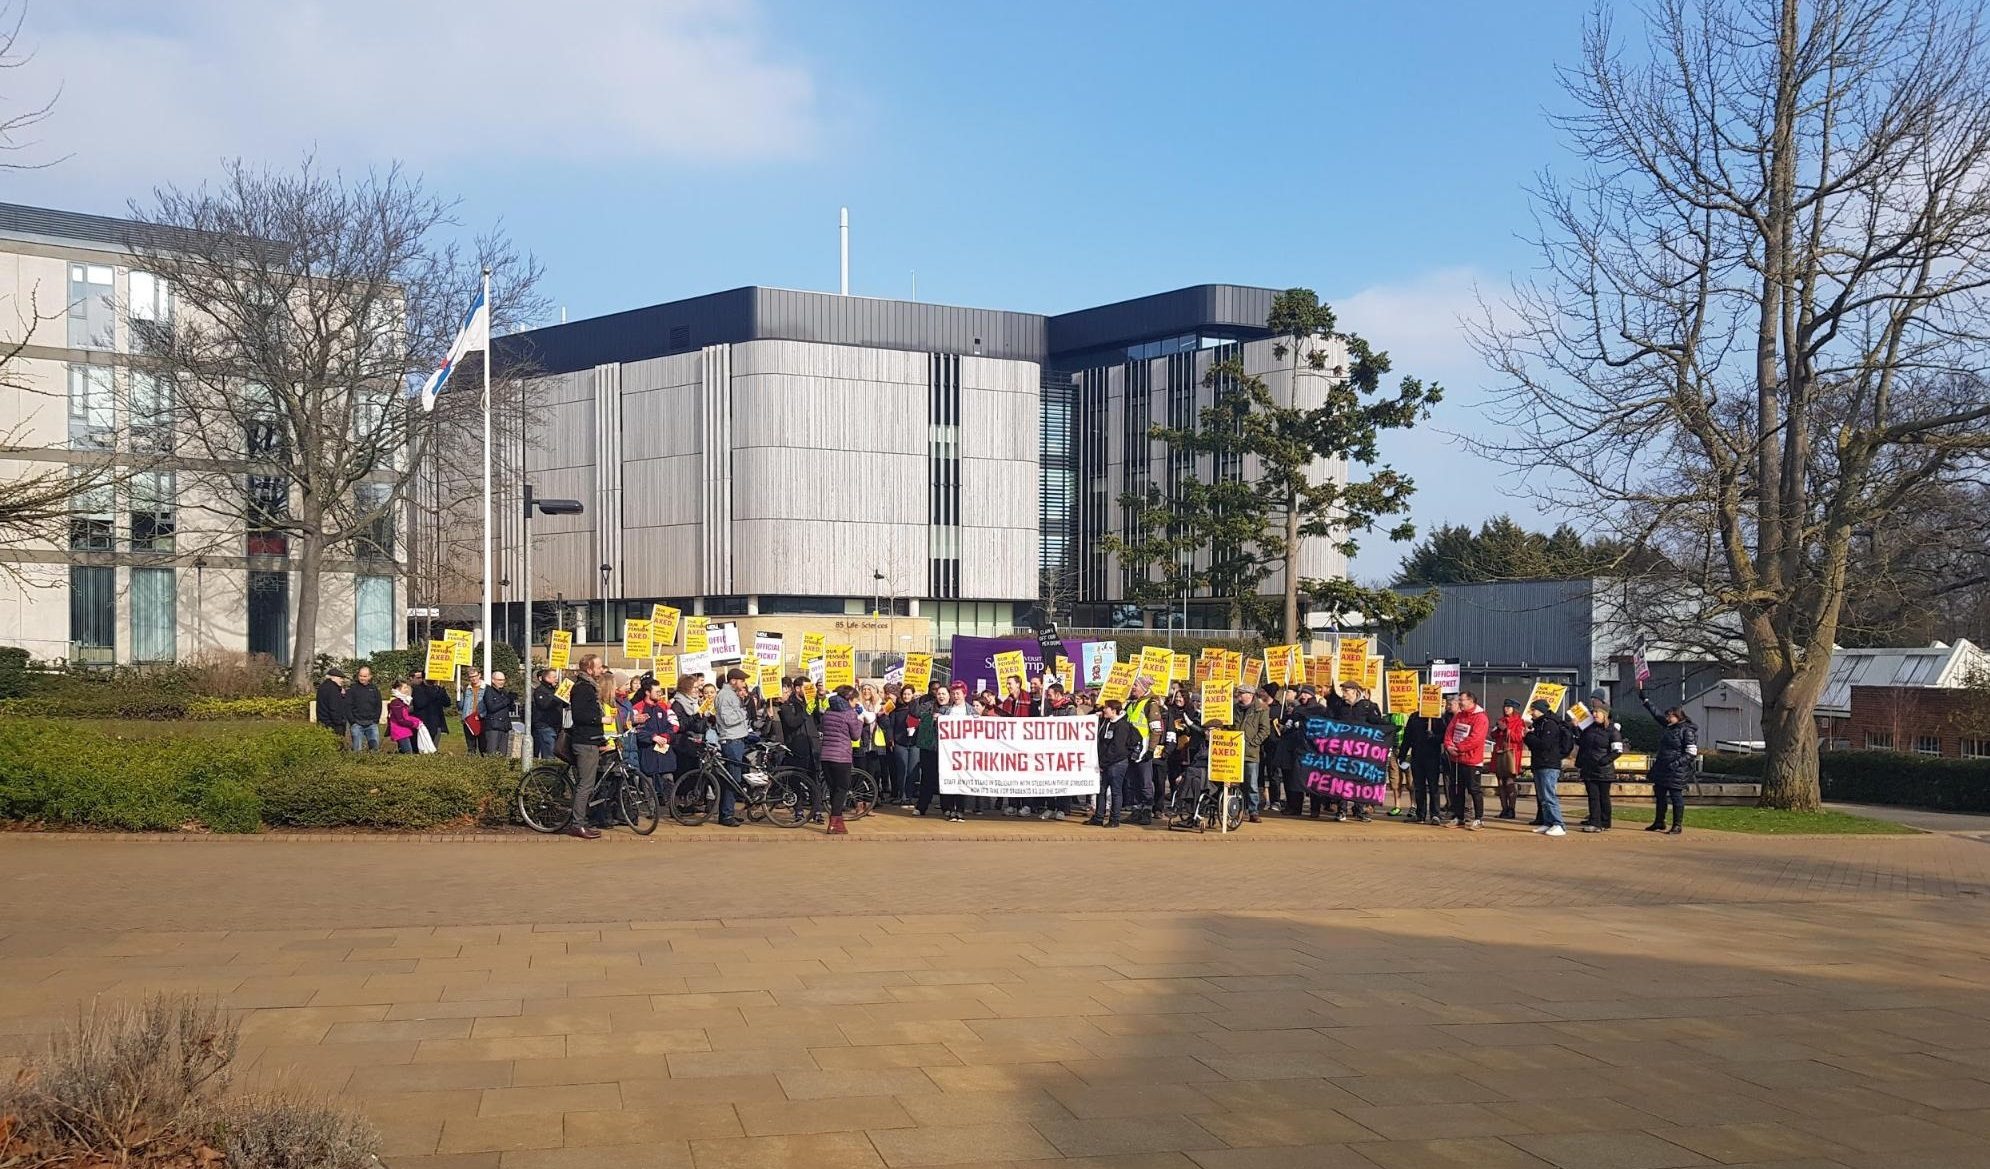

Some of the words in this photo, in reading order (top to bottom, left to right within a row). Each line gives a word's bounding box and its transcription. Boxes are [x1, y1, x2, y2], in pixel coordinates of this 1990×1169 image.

[847, 620, 858, 629] Life
[861, 621, 888, 629] Sciences
[712, 644, 736, 654] PICKET
[756, 643, 780, 651] OFFICIAL
[1341, 654, 1363, 662] AXED.
[1143, 663, 1168, 673] AXED.
[1391, 685, 1415, 693] AXED.
[1205, 695, 1229, 703] AXED.
[939, 720, 1017, 740] SUPPORT
[1023, 721, 1096, 741] SOTON'S
[1306, 718, 1351, 736] END
[1353, 725, 1385, 742] THE
[1212, 748, 1239, 756] AXED.
[1315, 738, 1388, 762] TENSION
[952, 751, 1028, 772] STRIKING
[1034, 752, 1086, 772] STAFF
[1301, 753, 1348, 772] SAVE
[1307, 771, 1387, 802] PENSION
